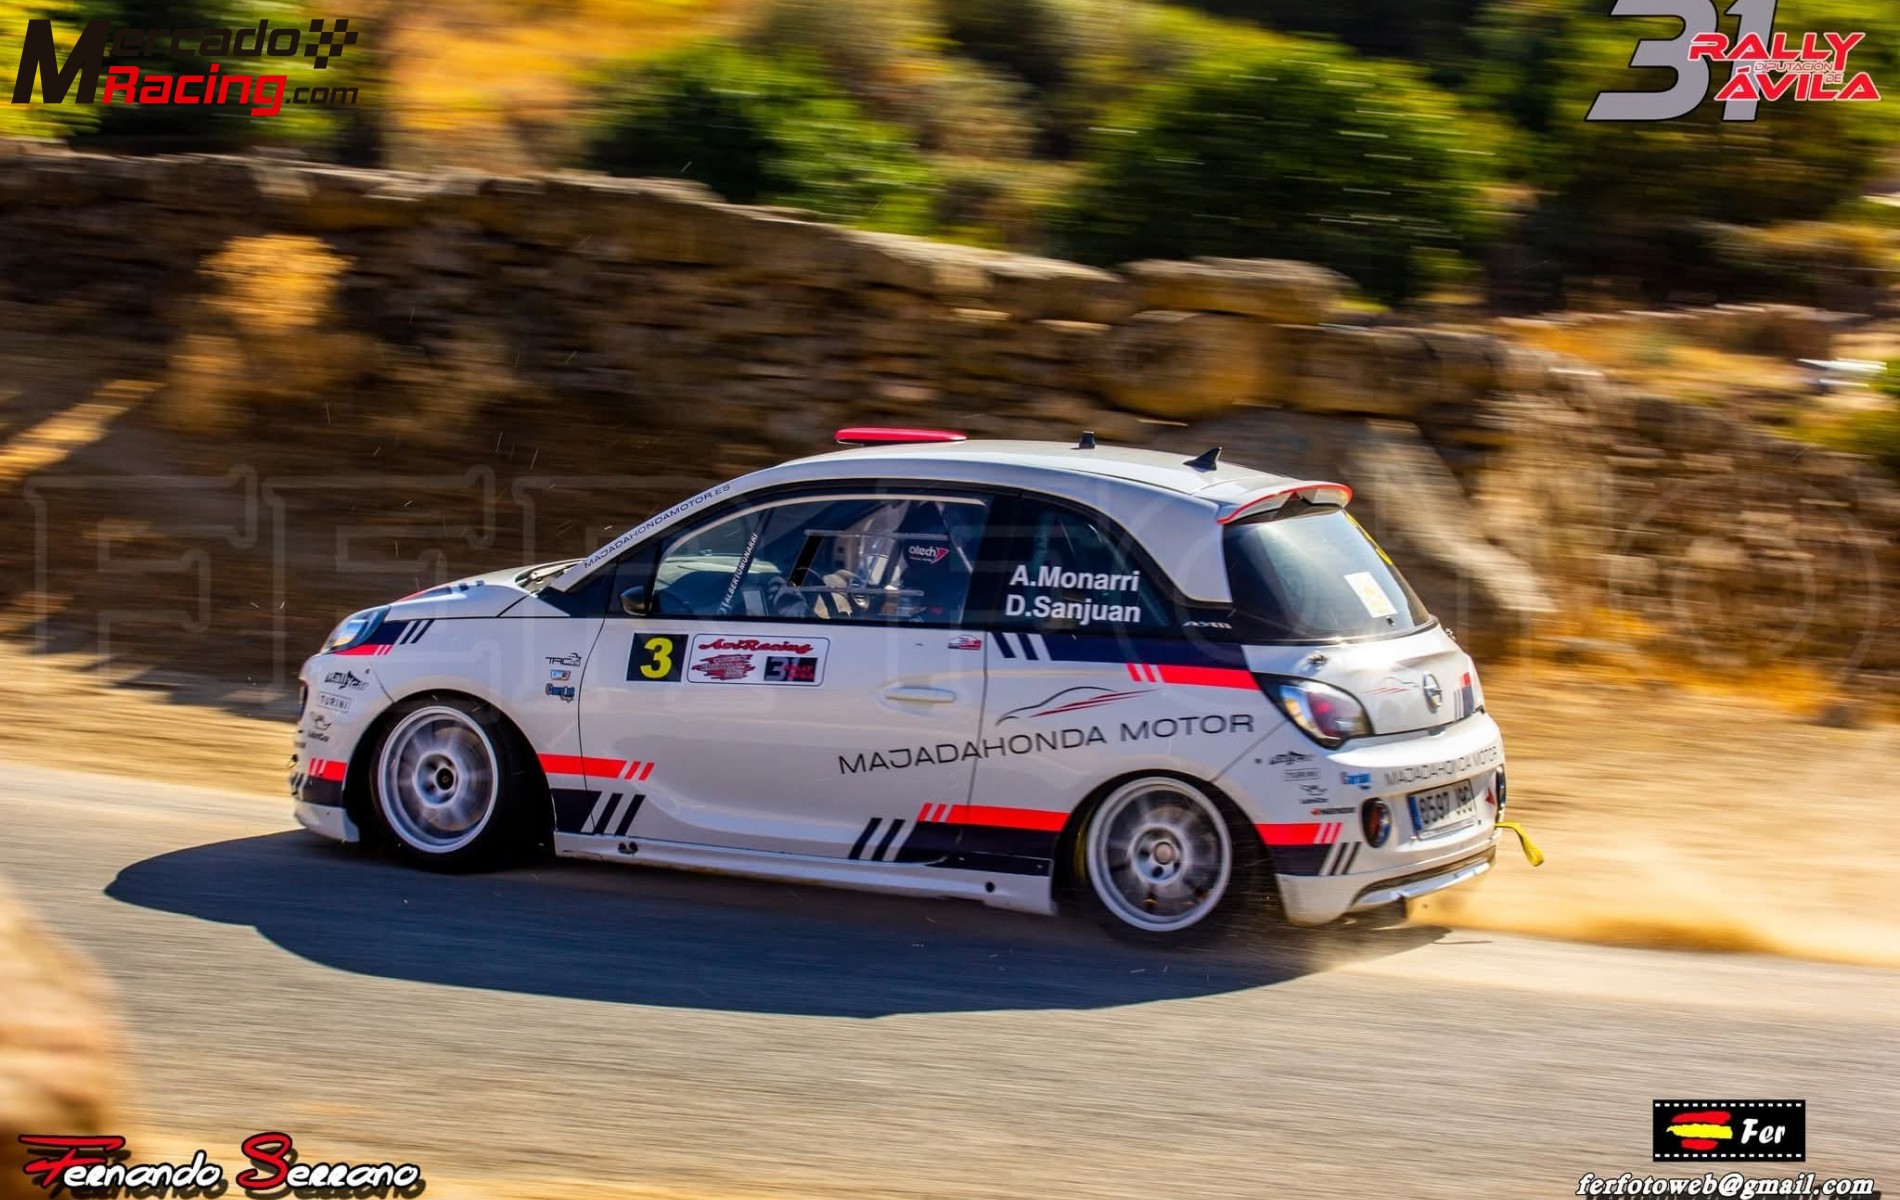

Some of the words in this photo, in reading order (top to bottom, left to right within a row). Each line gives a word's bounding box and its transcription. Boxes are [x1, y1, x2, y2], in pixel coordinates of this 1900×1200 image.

[584, 483, 731, 569] MAJADAHONDAMOTOR.ES
[1009, 564, 1140, 592] A.Monarri
[1005, 594, 1141, 626] D.Sanjuan
[640, 637, 673, 679] 3
[320, 694, 349, 711] TURINI
[838, 726, 1108, 774] MAJADAHONDA
[1120, 713, 1255, 742] MOTOR
[1384, 755, 1471, 785] MAJADAHONDA
